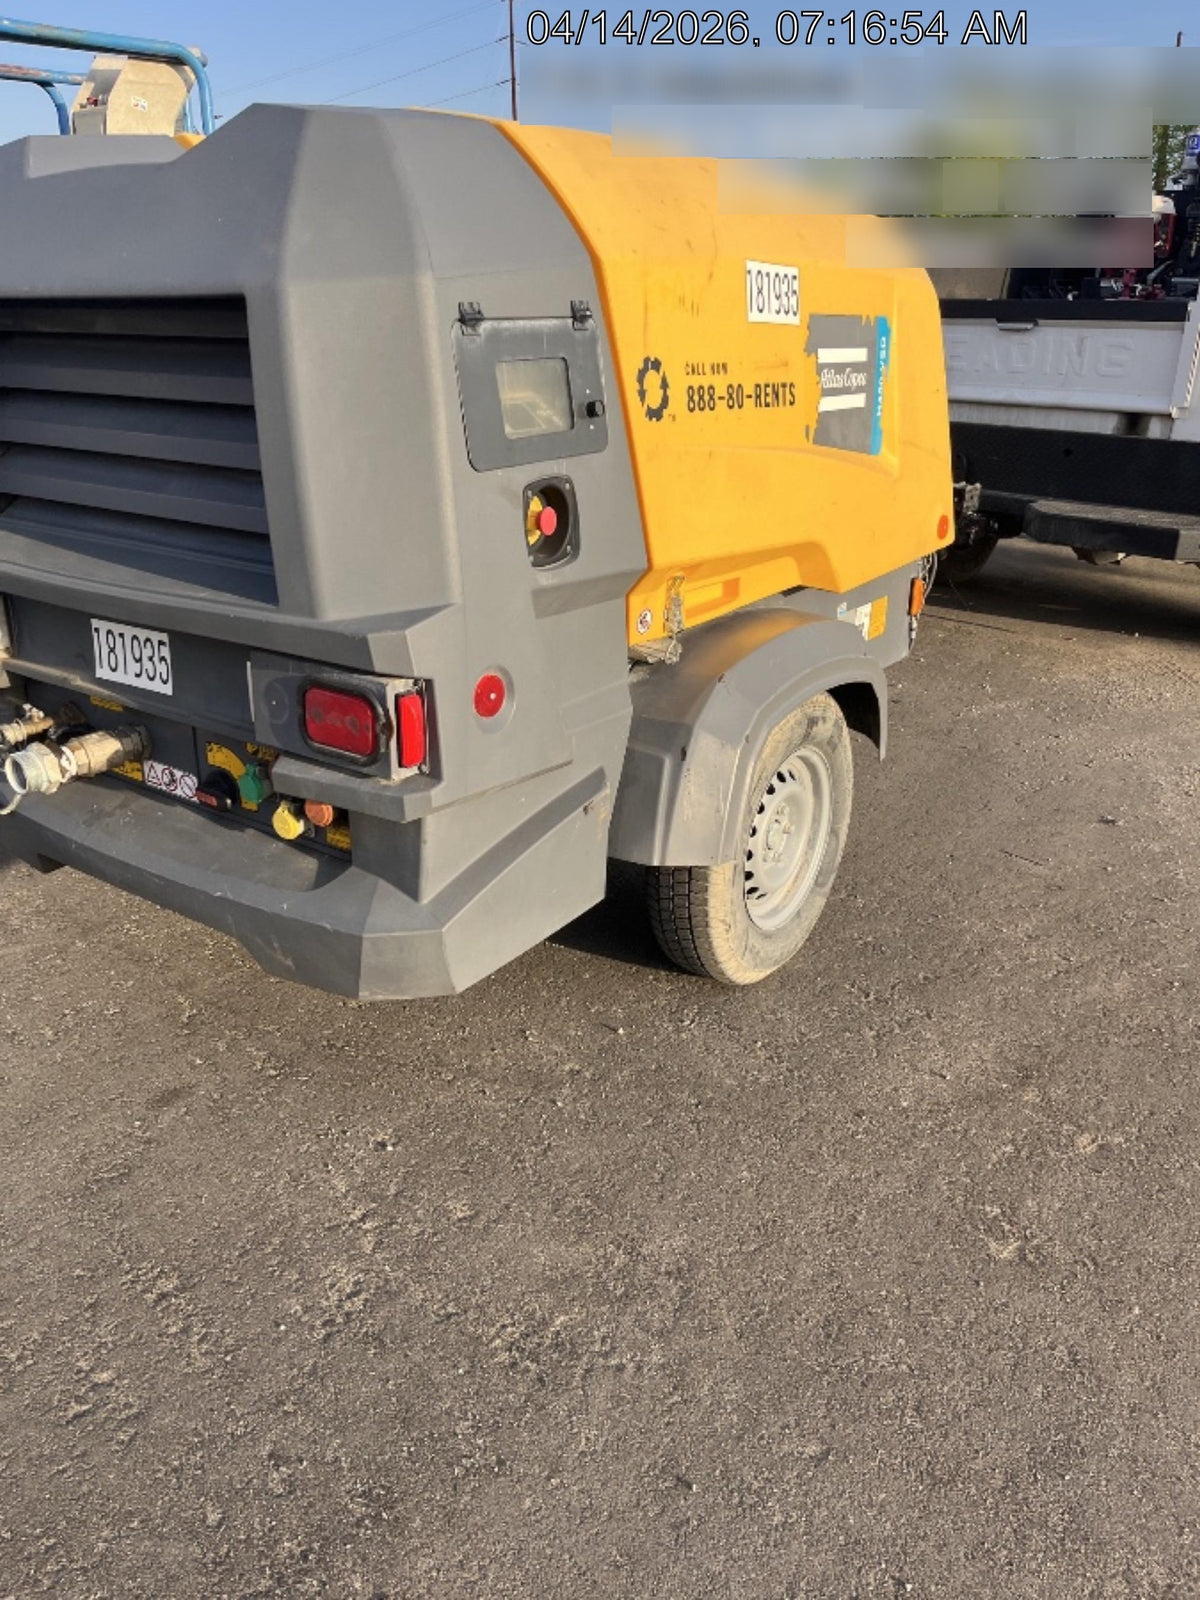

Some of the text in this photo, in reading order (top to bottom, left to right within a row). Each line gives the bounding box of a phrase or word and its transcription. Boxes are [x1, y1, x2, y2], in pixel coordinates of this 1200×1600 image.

[747, 269, 799, 317] 181935
[685, 362, 728, 376] CALL NOW
[687, 383, 795, 413] 888-80-RENTS
[94, 627, 171, 685] 181935
